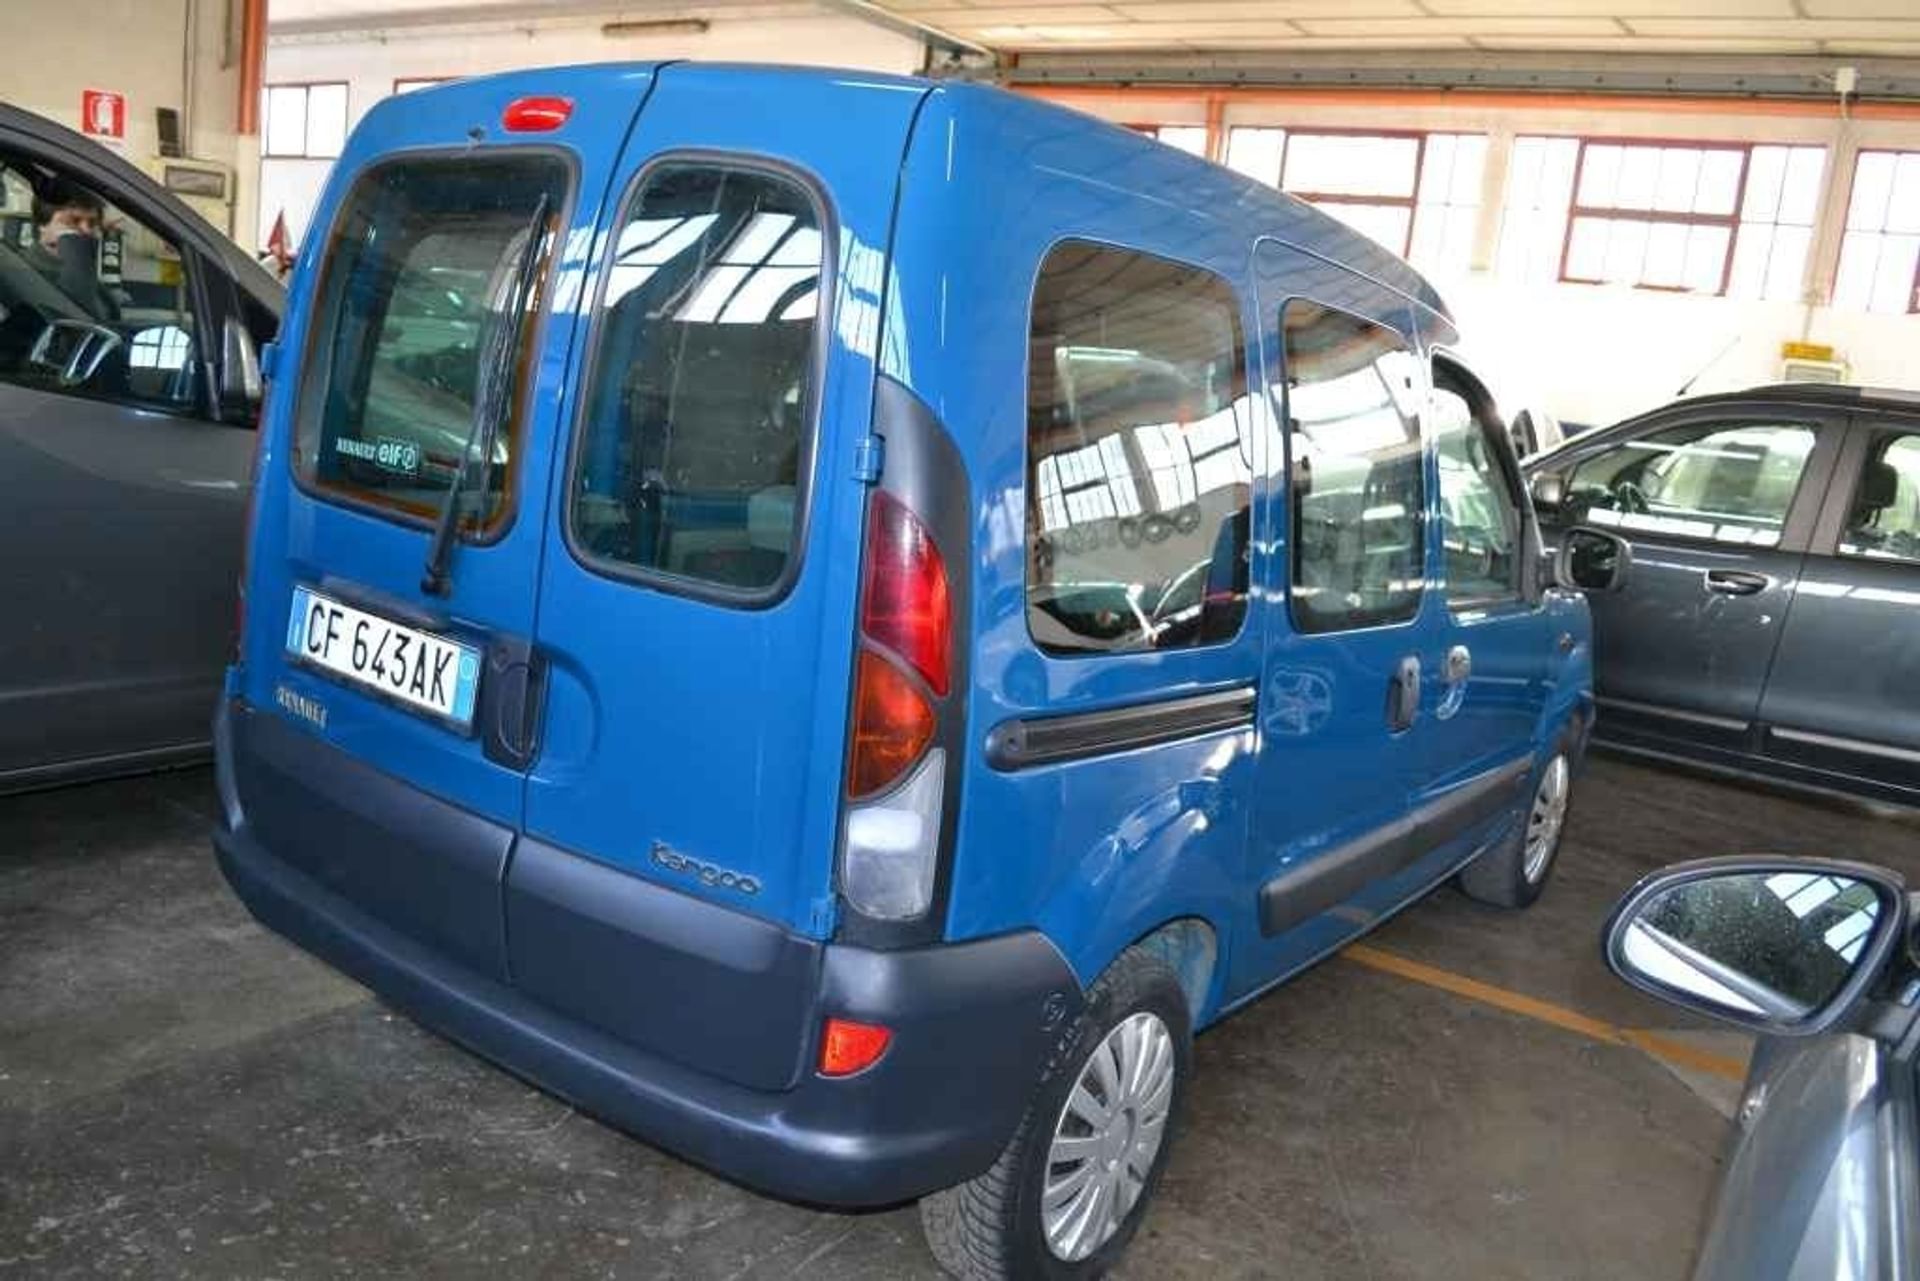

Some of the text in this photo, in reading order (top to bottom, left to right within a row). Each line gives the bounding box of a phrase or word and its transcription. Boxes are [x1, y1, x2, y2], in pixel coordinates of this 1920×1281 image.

[307, 601, 453, 707] CF 643AK
[650, 839, 762, 895] Kangoo
